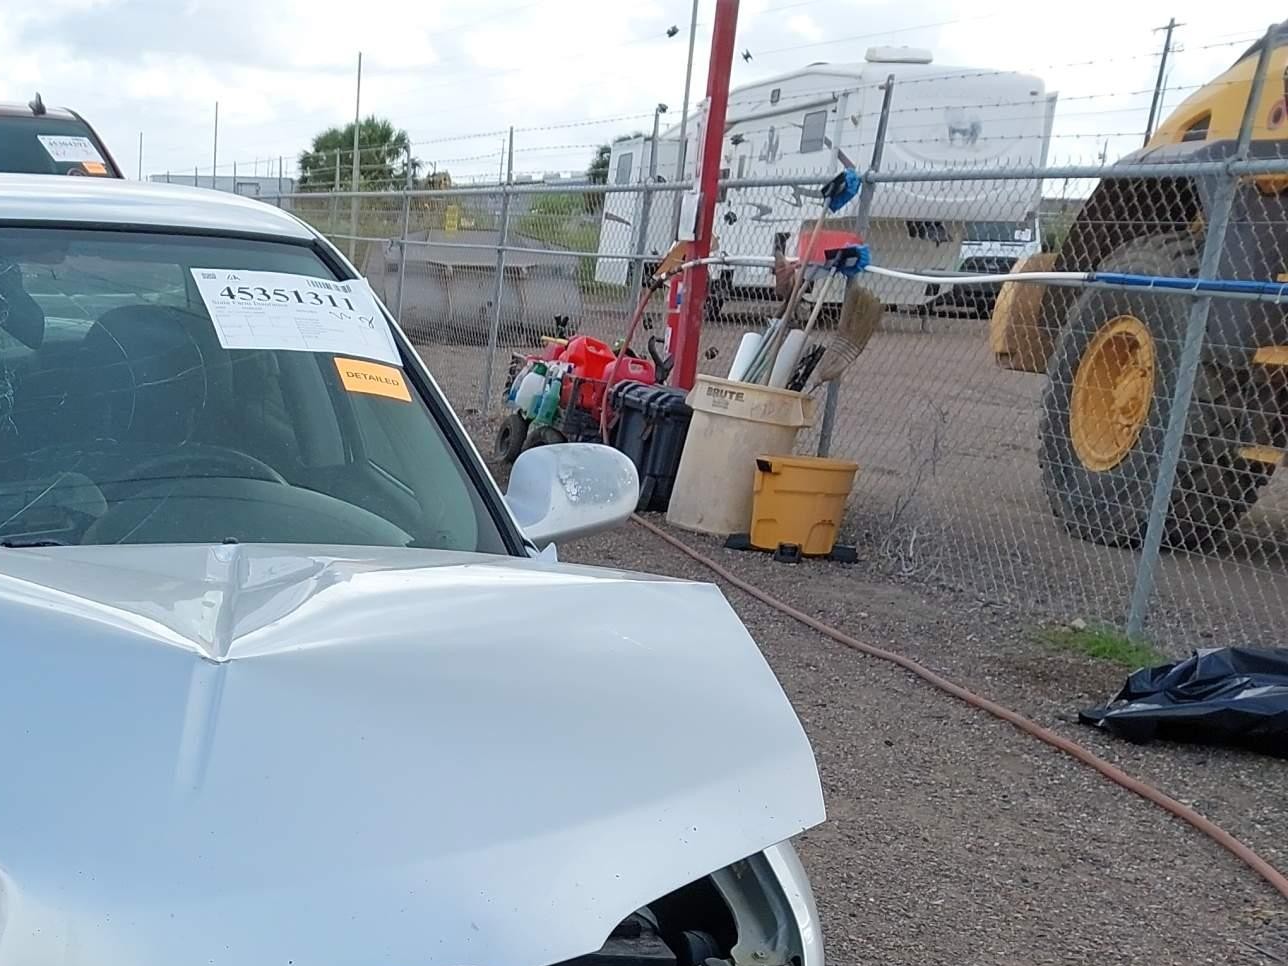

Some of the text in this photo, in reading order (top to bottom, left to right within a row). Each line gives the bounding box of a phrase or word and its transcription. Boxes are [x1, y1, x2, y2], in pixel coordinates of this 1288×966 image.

[220, 285, 355, 311] 45351311
[345, 371, 399, 386] DETAILED
[706, 386, 745, 402] BRUTE
